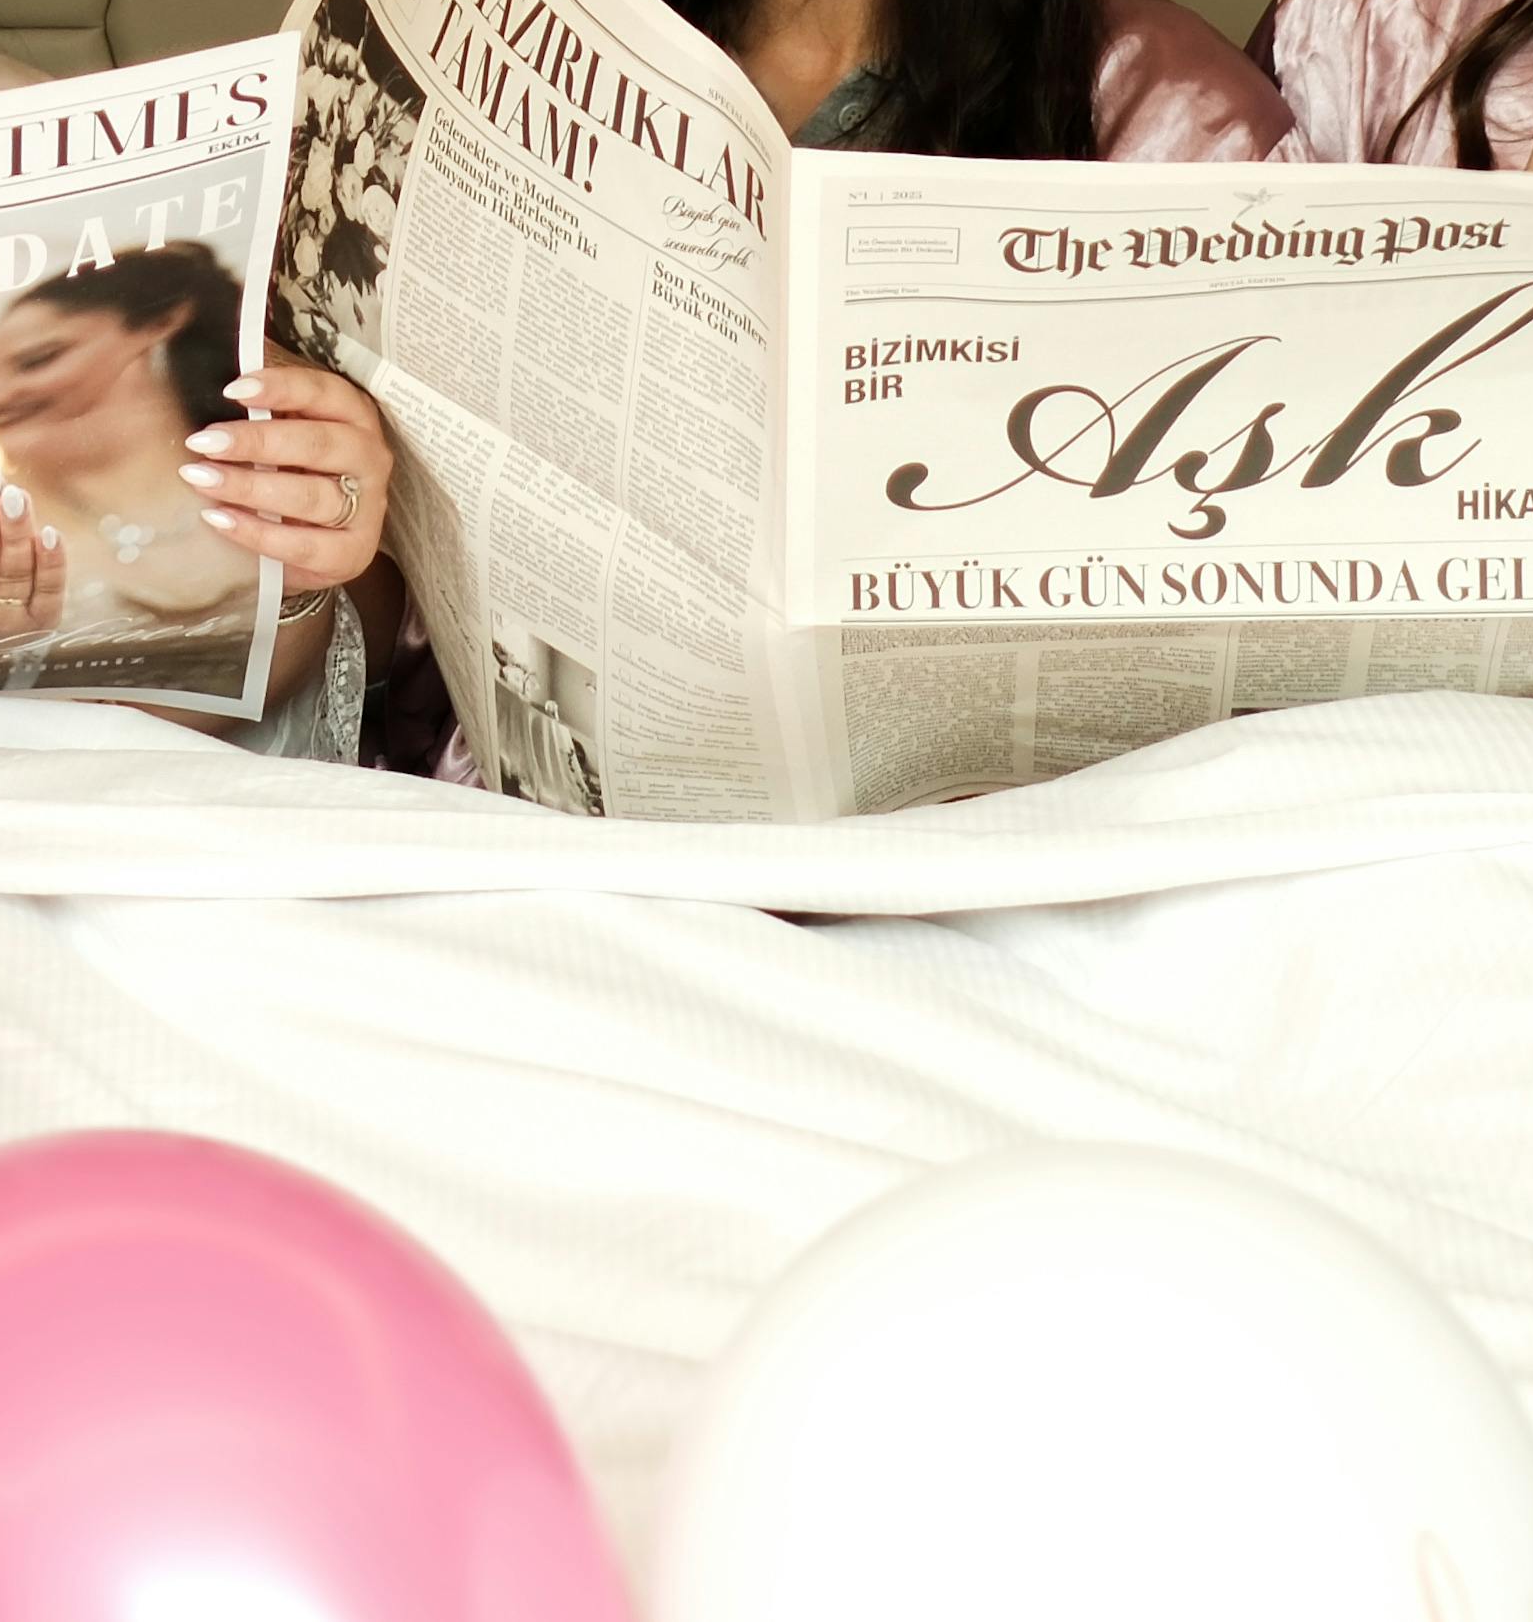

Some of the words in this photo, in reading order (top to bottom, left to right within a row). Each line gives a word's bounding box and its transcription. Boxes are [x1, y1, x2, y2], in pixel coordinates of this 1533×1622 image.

[207, 130, 263, 155] EKİM
[435, 107, 501, 172] Gelenekler
[504, 167, 520, 188] ve
[523, 177, 579, 229] Modern
[424, 145, 488, 208] Dünyanın
[513, 193, 573, 243] Birleşen
[576, 233, 598, 261] İki
[999, 224, 1112, 281] The
[1124, 215, 1366, 269] Wedding
[1371, 216, 1512, 266] Post
[654, 260, 684, 290] Son
[652, 279, 703, 322] Büyük
[706, 311, 739, 345] Gün
[845, 334, 1021, 371] BİZİMKİSİ
[845, 373, 903, 404] BİR
[849, 562, 1028, 613] BÜYÜK
[1038, 556, 1147, 609] GÜN
[1161, 556, 1421, 611] SONUNDA
